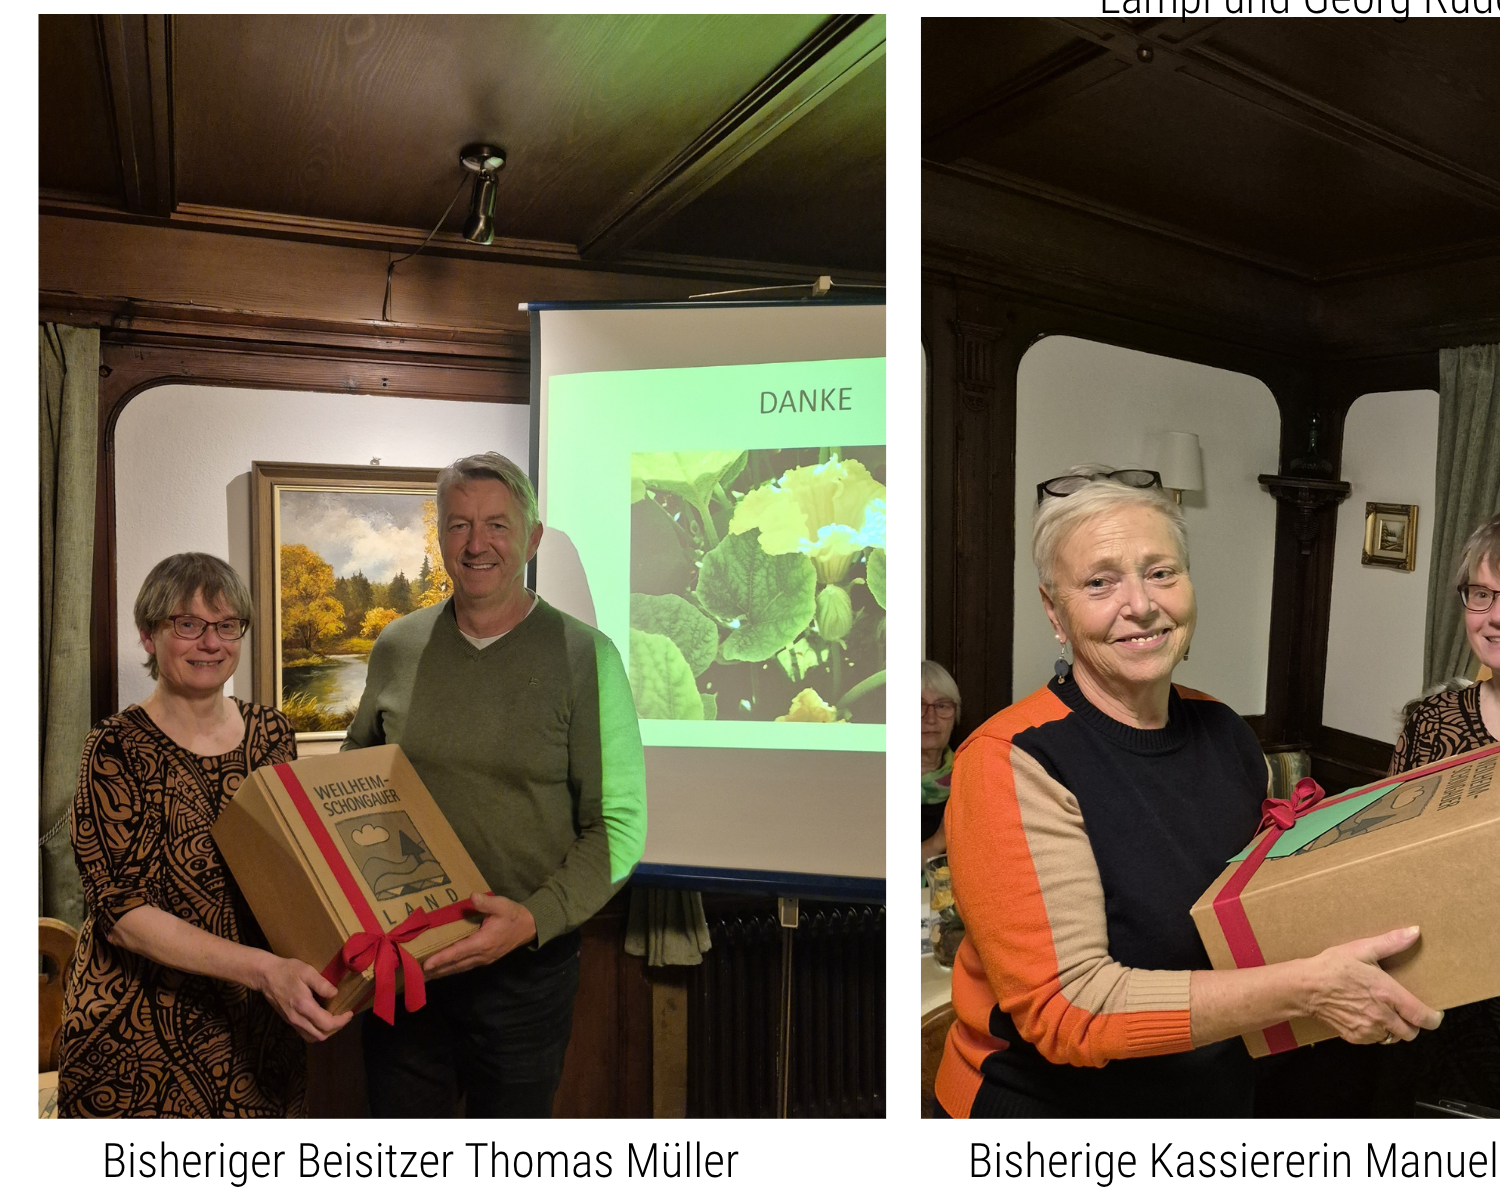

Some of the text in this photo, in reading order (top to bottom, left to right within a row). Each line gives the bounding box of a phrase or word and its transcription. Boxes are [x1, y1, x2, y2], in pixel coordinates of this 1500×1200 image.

[759, 387, 853, 415] DANKE
[313, 774, 389, 801] WEILHEIM-
[323, 788, 401, 817] SCHONGAUER
[382, 887, 459, 926] LAND
